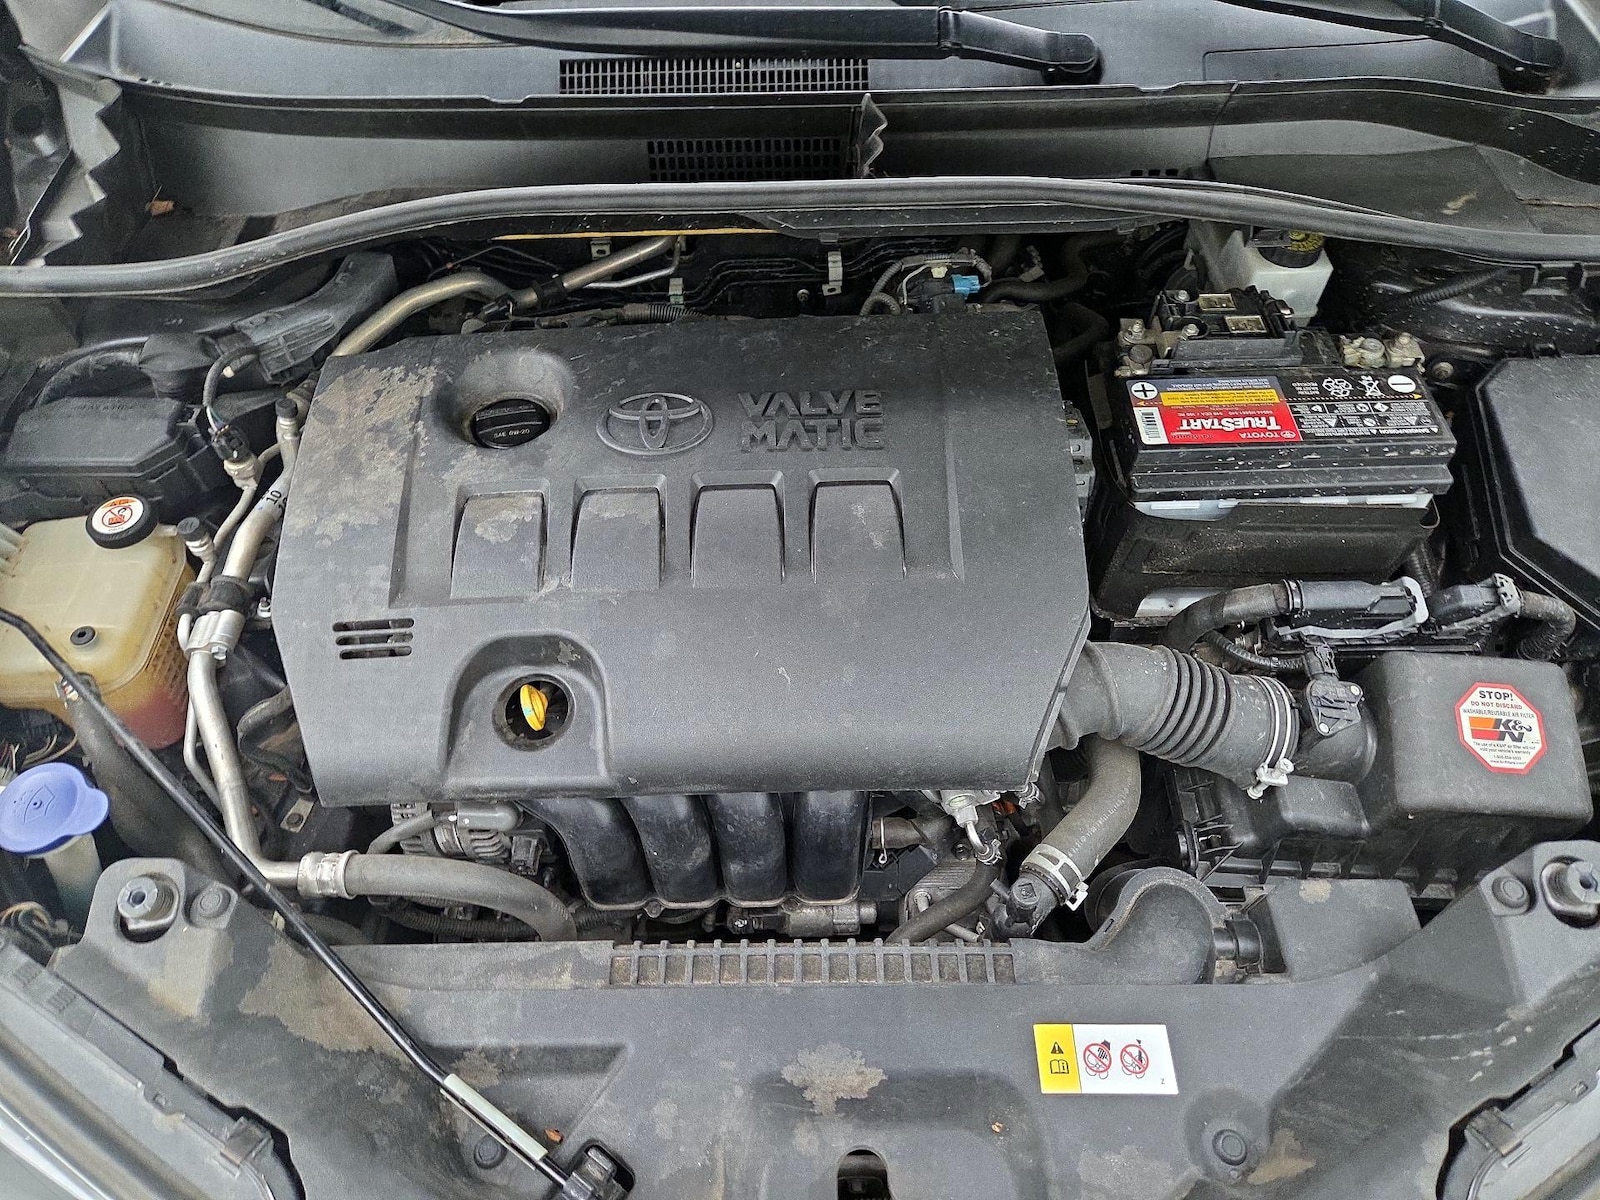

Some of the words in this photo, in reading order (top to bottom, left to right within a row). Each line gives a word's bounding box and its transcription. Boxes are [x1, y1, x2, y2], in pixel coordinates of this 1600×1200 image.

[738, 390, 883, 417] VALVE
[740, 418, 885, 451] MATIC
[266, 490, 282, 504] 10
[1478, 690, 1514, 701] STOP!
[1496, 702, 1522, 710] DISCARD
